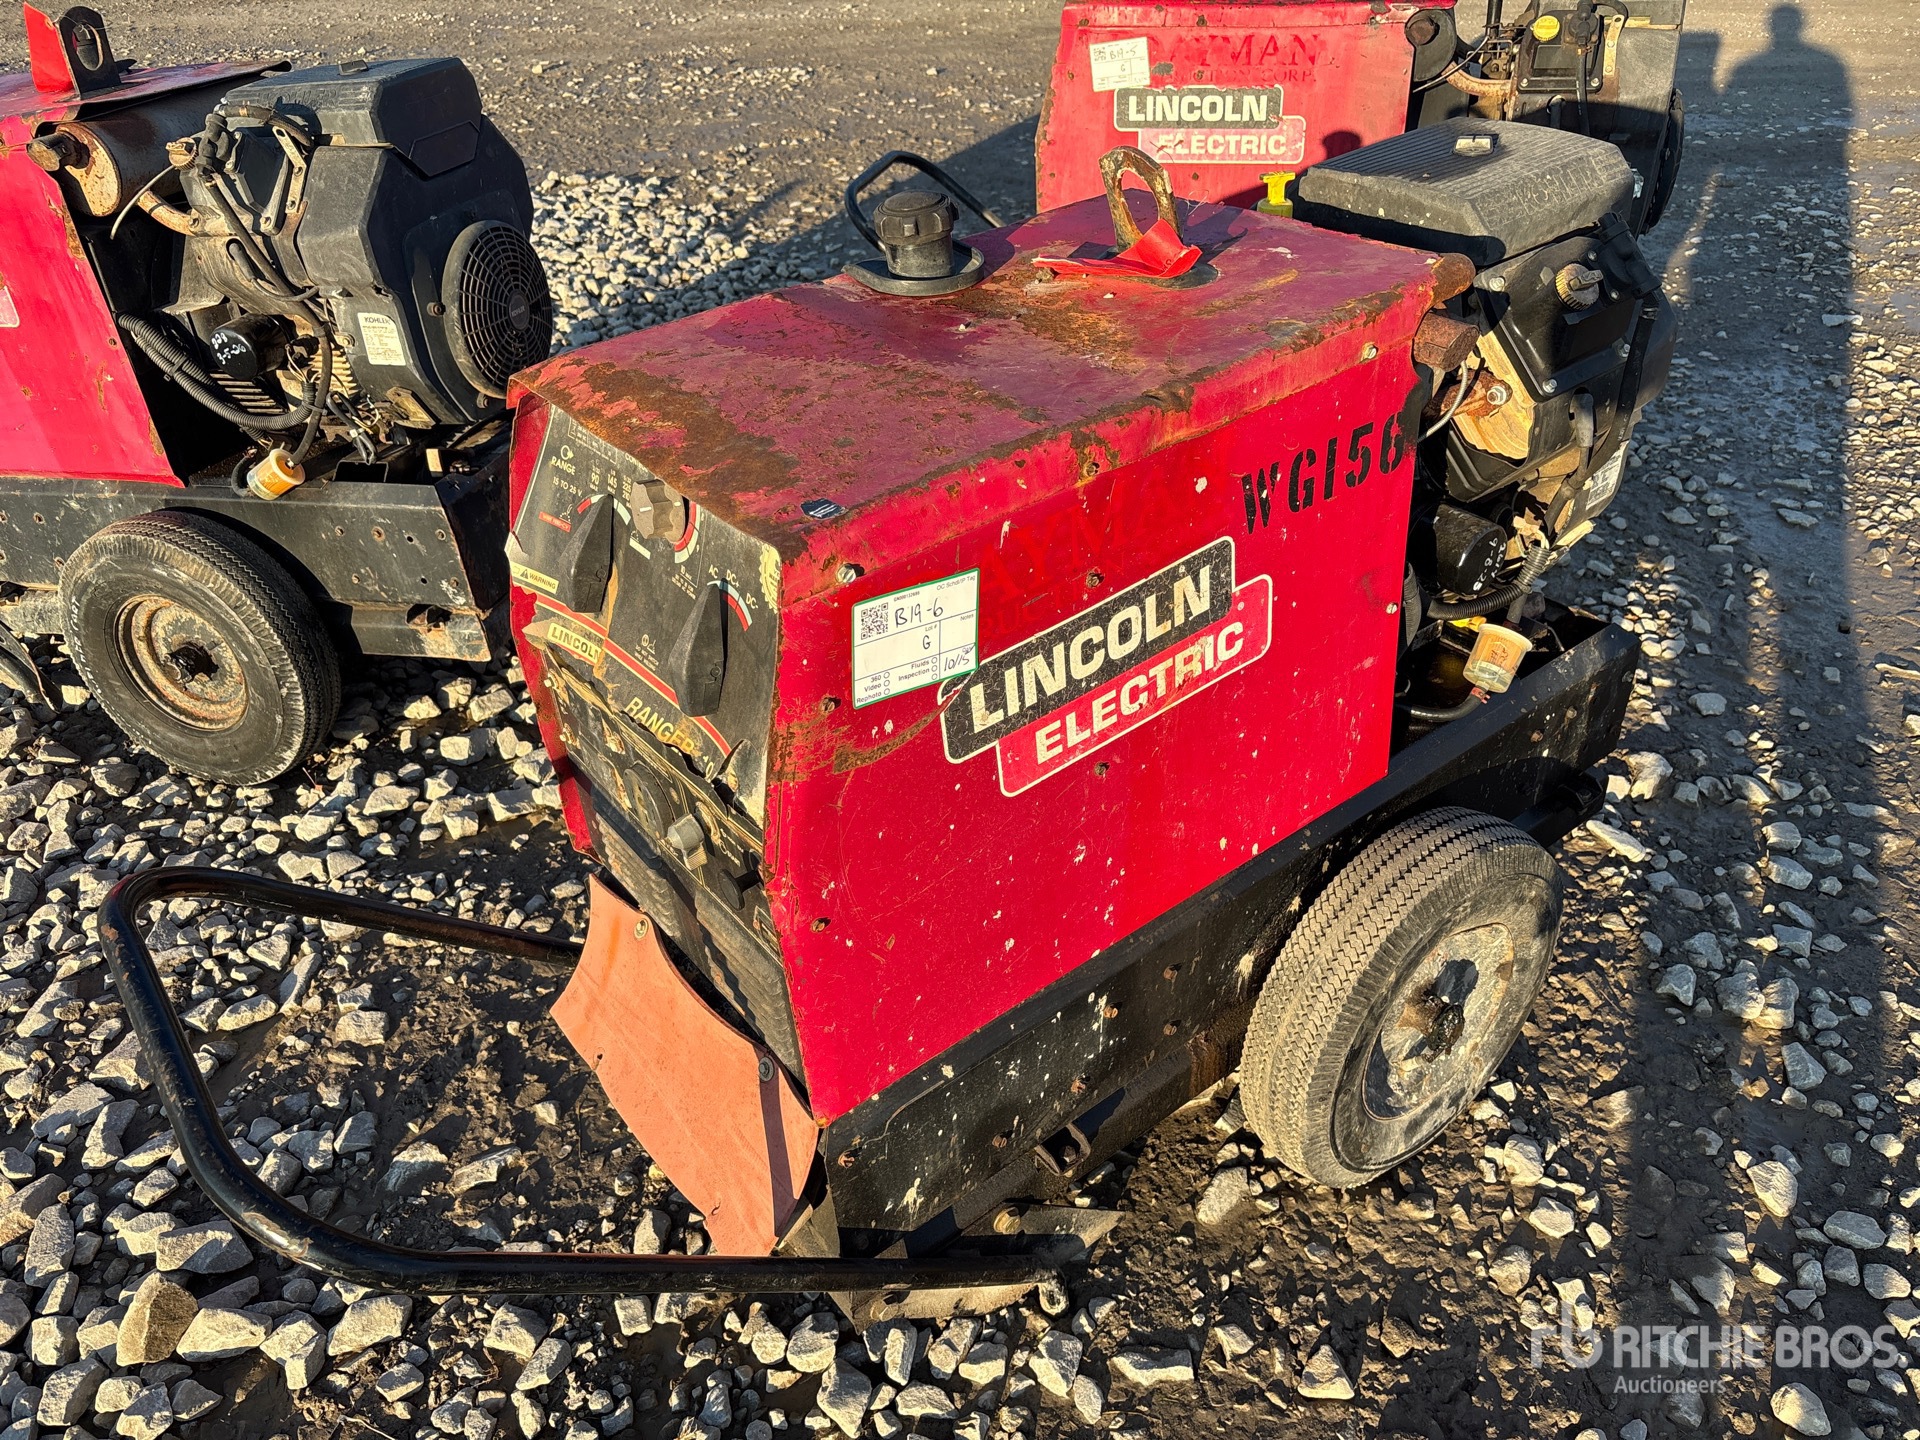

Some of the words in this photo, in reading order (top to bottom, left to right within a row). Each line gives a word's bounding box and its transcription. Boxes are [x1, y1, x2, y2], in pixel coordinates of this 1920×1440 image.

[1128, 95, 1268, 122] LINCOLN
[1157, 133, 1288, 156] ELECTRIC
[551, 456, 576, 476] RANGE
[552, 476, 560, 486] 15
[560, 480, 569, 490] TO
[569, 485, 577, 495] 25
[591, 472, 600, 485] 90
[607, 473, 618, 489] 145
[708, 564, 719, 579] AC
[726, 569, 740, 588] DC+
[529, 572, 556, 590] WARNING
[745, 592, 759, 610] DC-
[960, 613, 974, 622] Notes
[551, 626, 601, 661] LINCOLN
[969, 566, 1211, 735] LINCOLN
[910, 660, 930, 670] Fluids
[943, 653, 970, 672] 10/15
[870, 674, 882, 683] 360
[898, 668, 930, 682] Inspection
[863, 683, 882, 693] Video
[1034, 621, 1245, 765] ELECTRIC
[856, 691, 882, 704] Rephoto
[623, 697, 696, 755] RANGER
